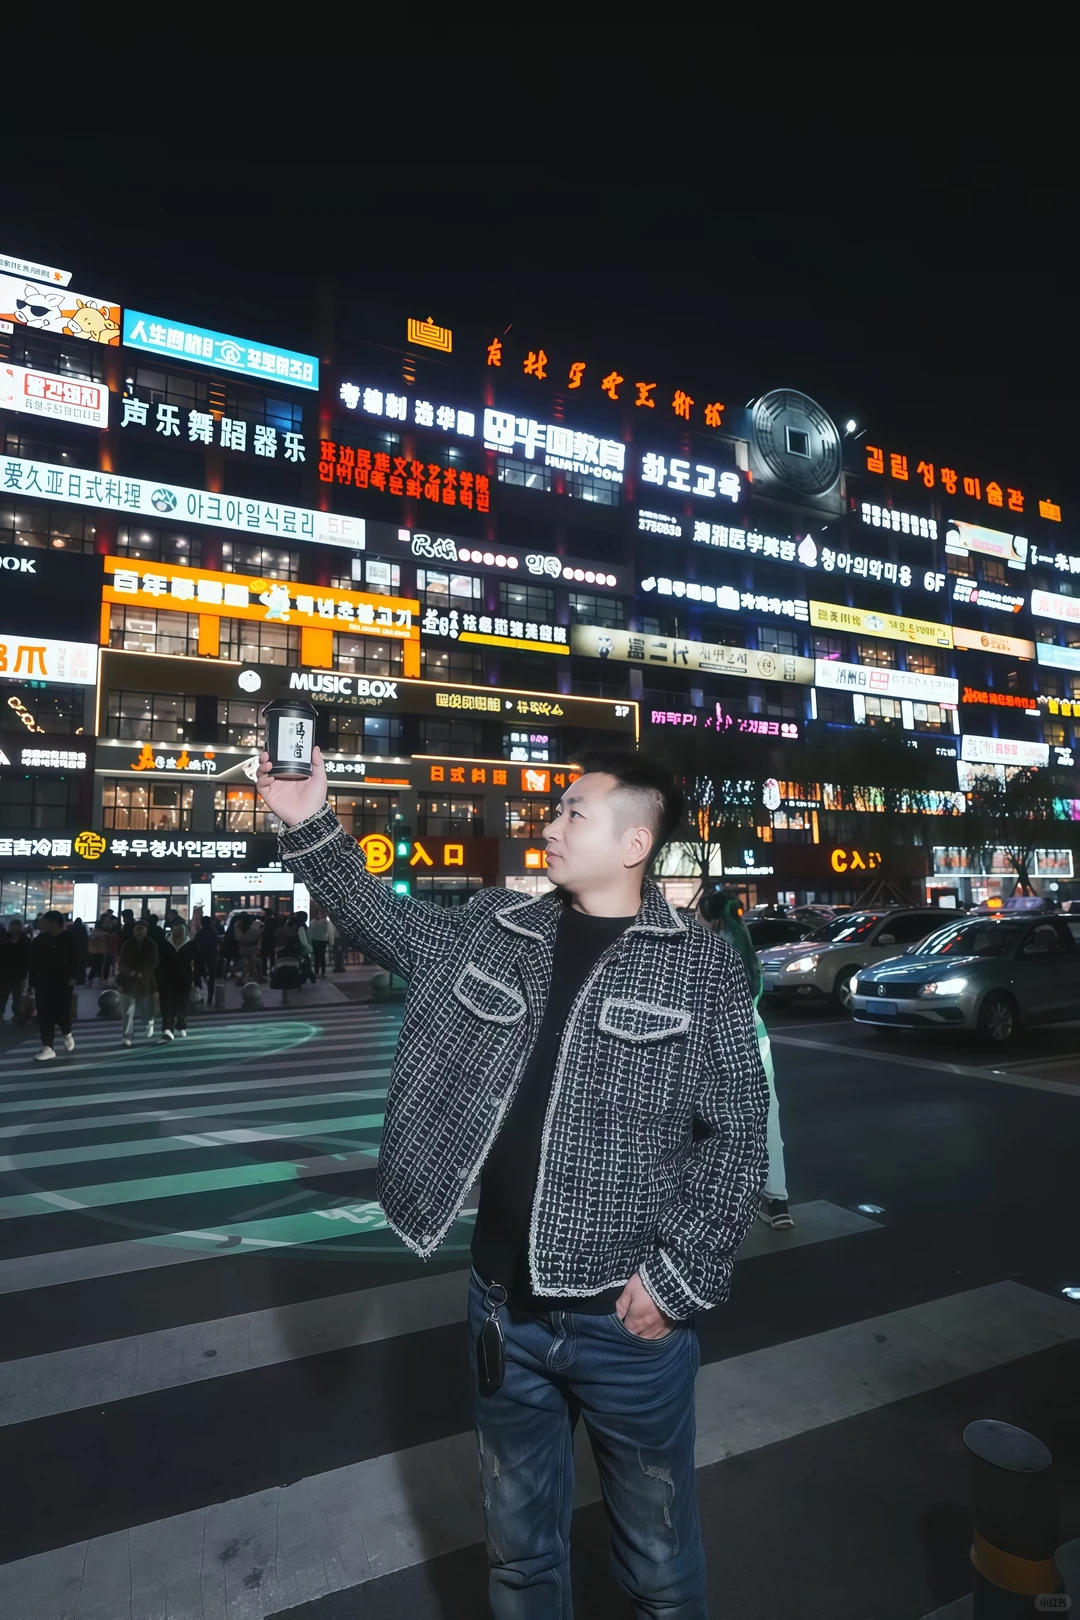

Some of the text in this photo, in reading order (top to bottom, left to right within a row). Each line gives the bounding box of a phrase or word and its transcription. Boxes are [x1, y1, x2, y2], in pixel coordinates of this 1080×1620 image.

[0, 556, 37, 573] OK
[923, 571, 946, 592] 6F
[289, 672, 352, 695] MUSIC
[357, 679, 398, 699] BOX
[410, 842, 464, 866] 入口
